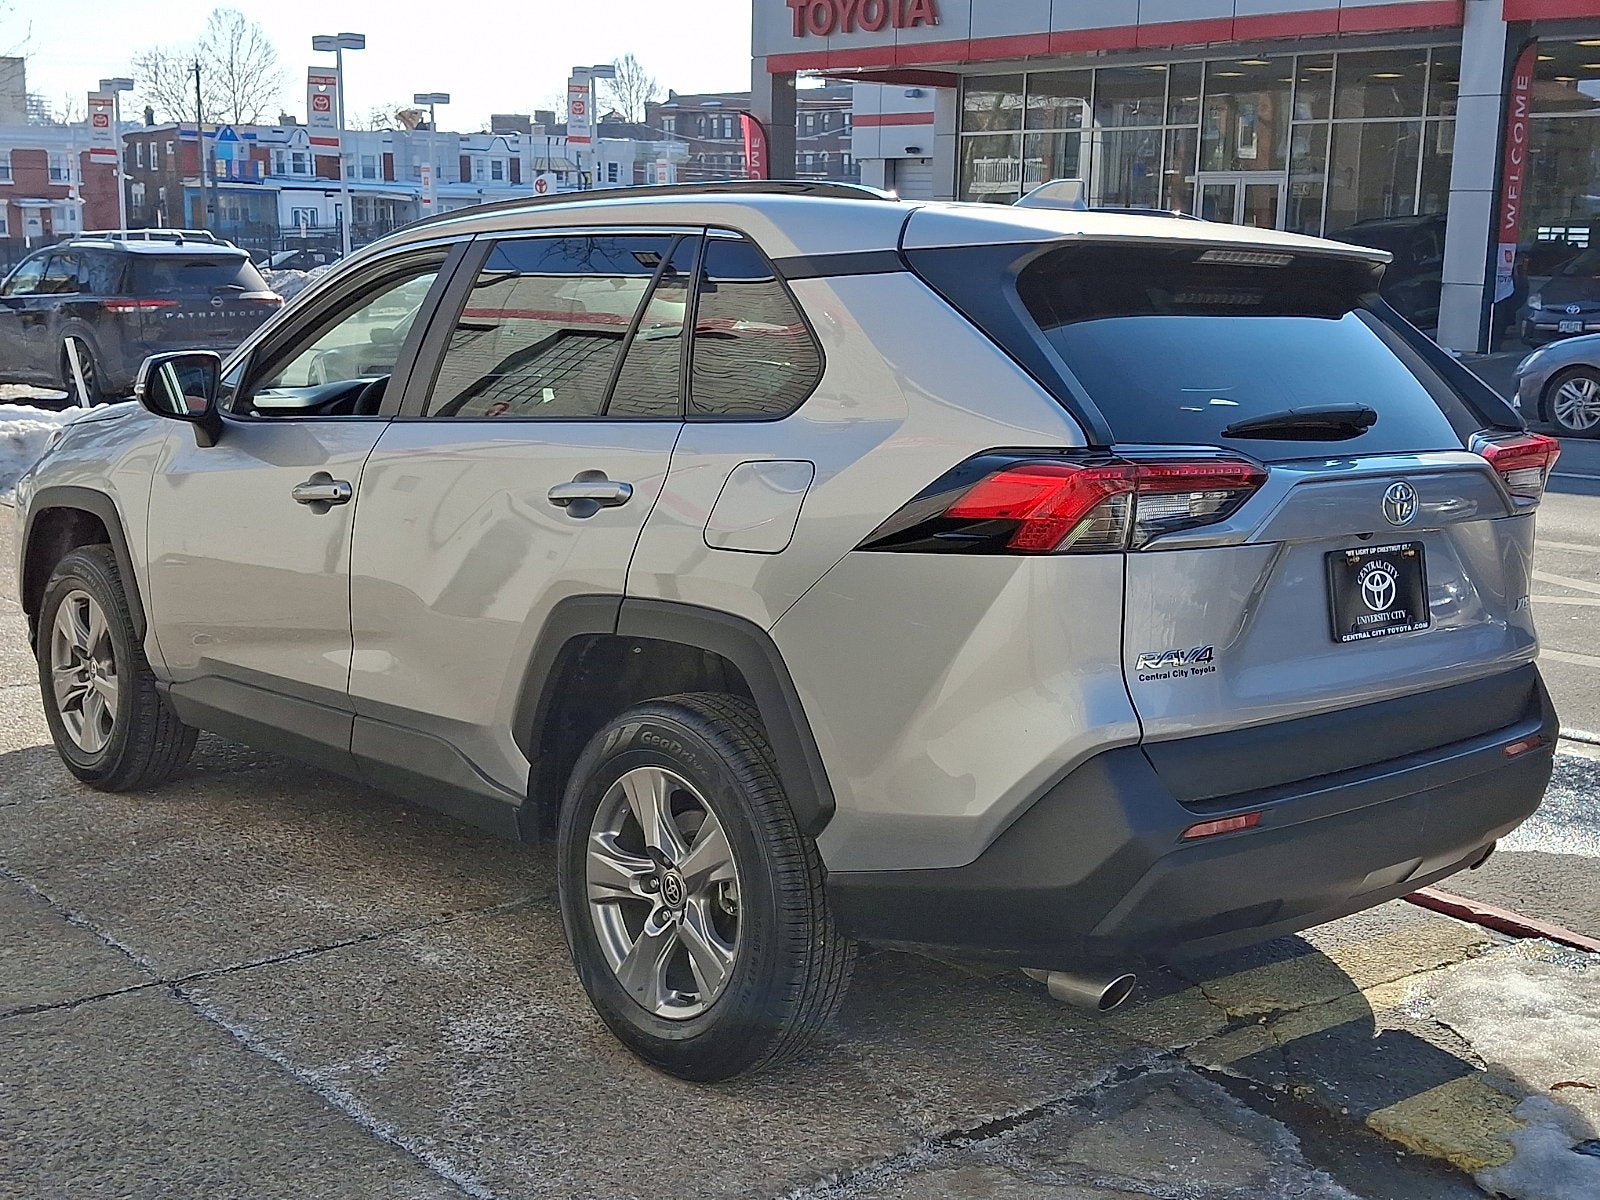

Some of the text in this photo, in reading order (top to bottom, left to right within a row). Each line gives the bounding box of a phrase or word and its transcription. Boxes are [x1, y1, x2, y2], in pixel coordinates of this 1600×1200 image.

[786, 0, 939, 37] TOYOTA
[1505, 75, 1529, 230] WELCOME
[1357, 560, 1399, 584] CENTRAL CITY
[1357, 609, 1407, 624] UNIVERSITY CITY
[1342, 631, 1370, 641] CENTRAL
[1371, 628, 1386, 637] CITY
[1386, 624, 1412, 635] TOYOTA
[1135, 645, 1214, 671] RAV4
[1138, 665, 1216, 682] Central City Toyota
